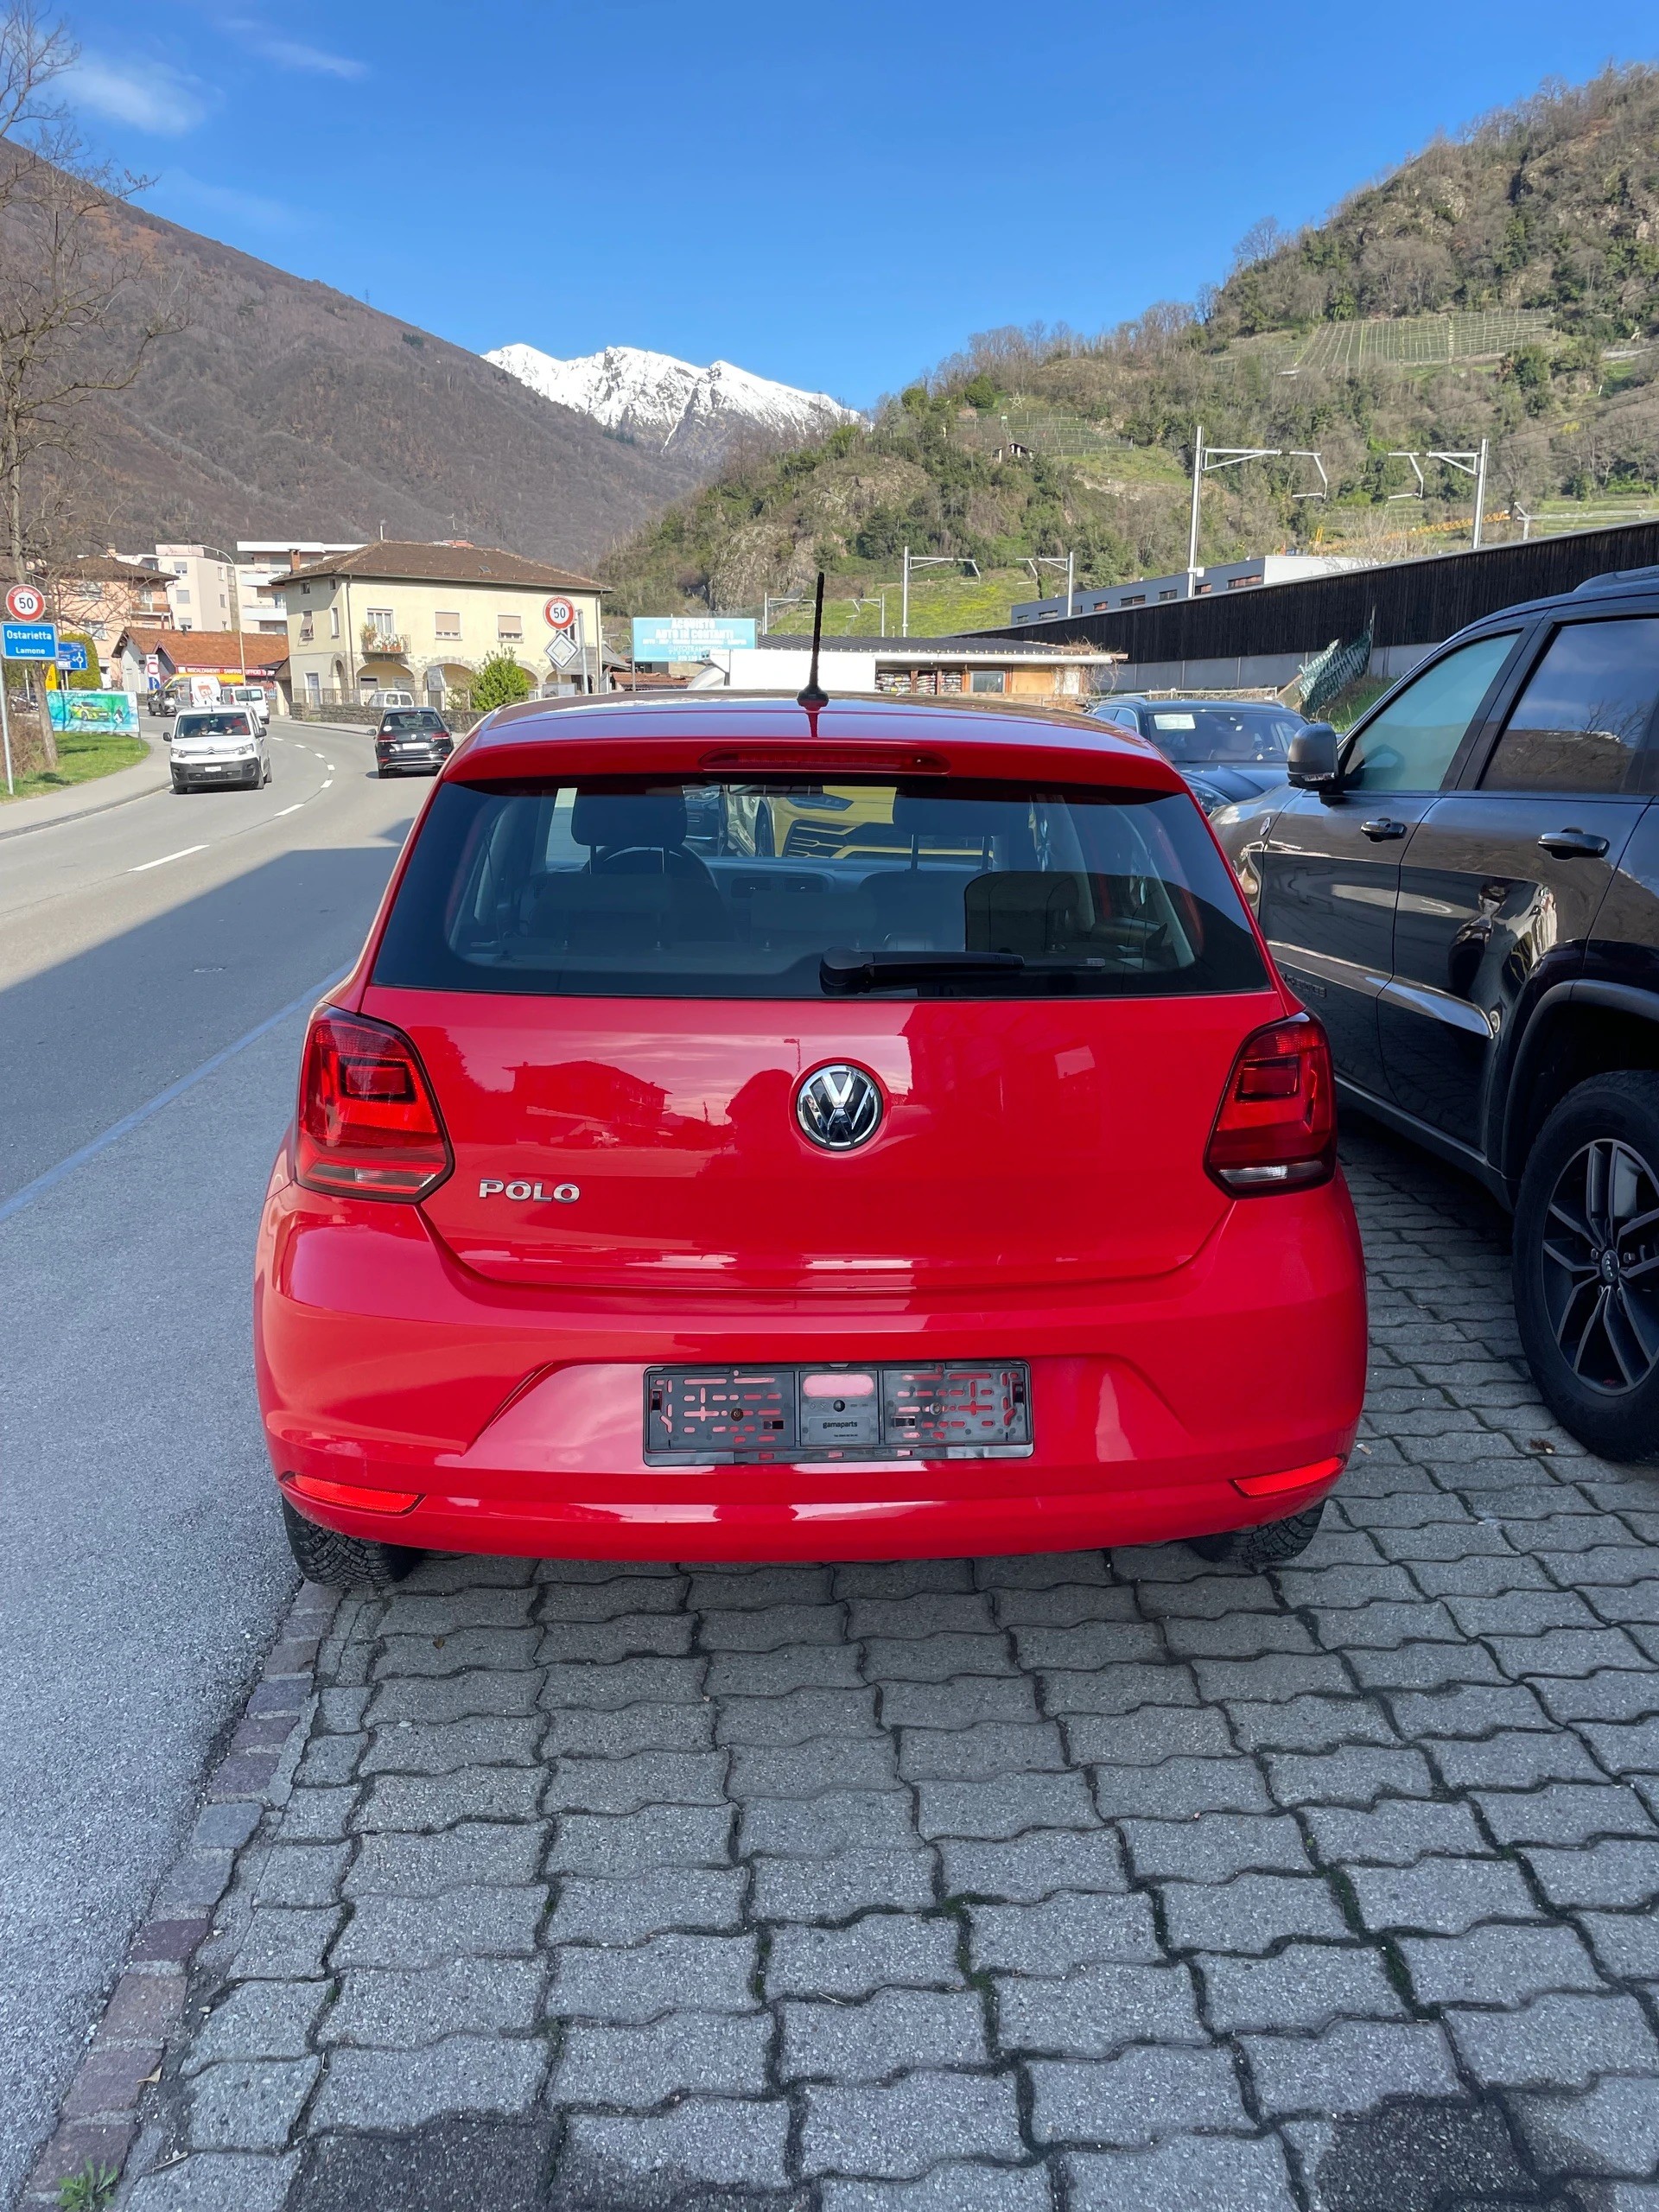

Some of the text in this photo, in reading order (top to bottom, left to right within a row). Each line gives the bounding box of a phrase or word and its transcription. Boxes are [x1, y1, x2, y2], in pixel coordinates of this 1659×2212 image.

[19, 597, 34, 609] 50
[553, 607, 566, 619] 50
[6, 630, 52, 640] Ostarietta
[691, 630, 734, 639] CONTANTI
[479, 1179, 580, 1204] POLO
